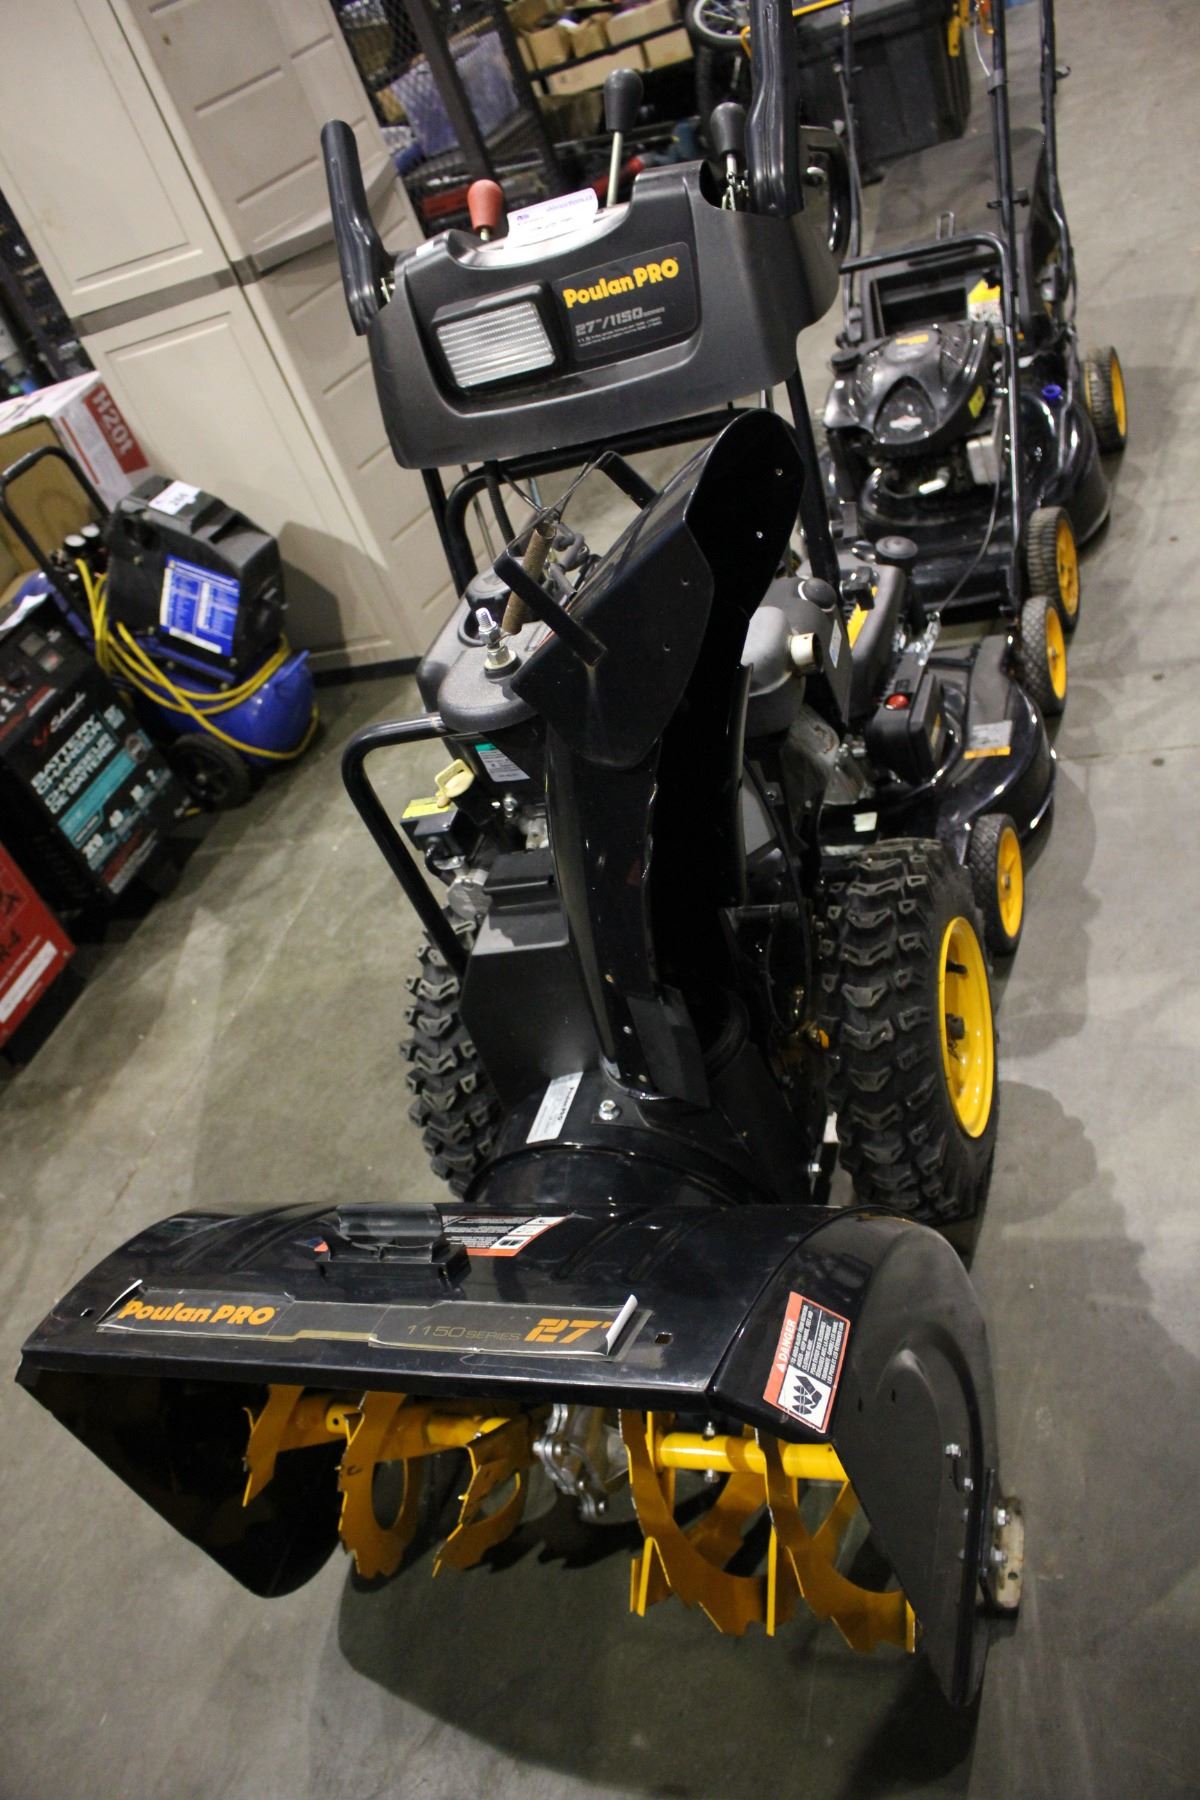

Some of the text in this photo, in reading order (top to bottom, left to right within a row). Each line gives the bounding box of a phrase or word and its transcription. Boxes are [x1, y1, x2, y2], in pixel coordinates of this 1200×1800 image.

[563, 258, 679, 308] Poulan PRO
[31, 714, 95, 787] BATTERY
[36, 721, 102, 795] CHARGER
[117, 1300, 276, 1325] Poulan PRO
[408, 1325, 465, 1338] 1150
[465, 1330, 521, 1341] SERIES
[779, 1319, 797, 1362] DANGER
